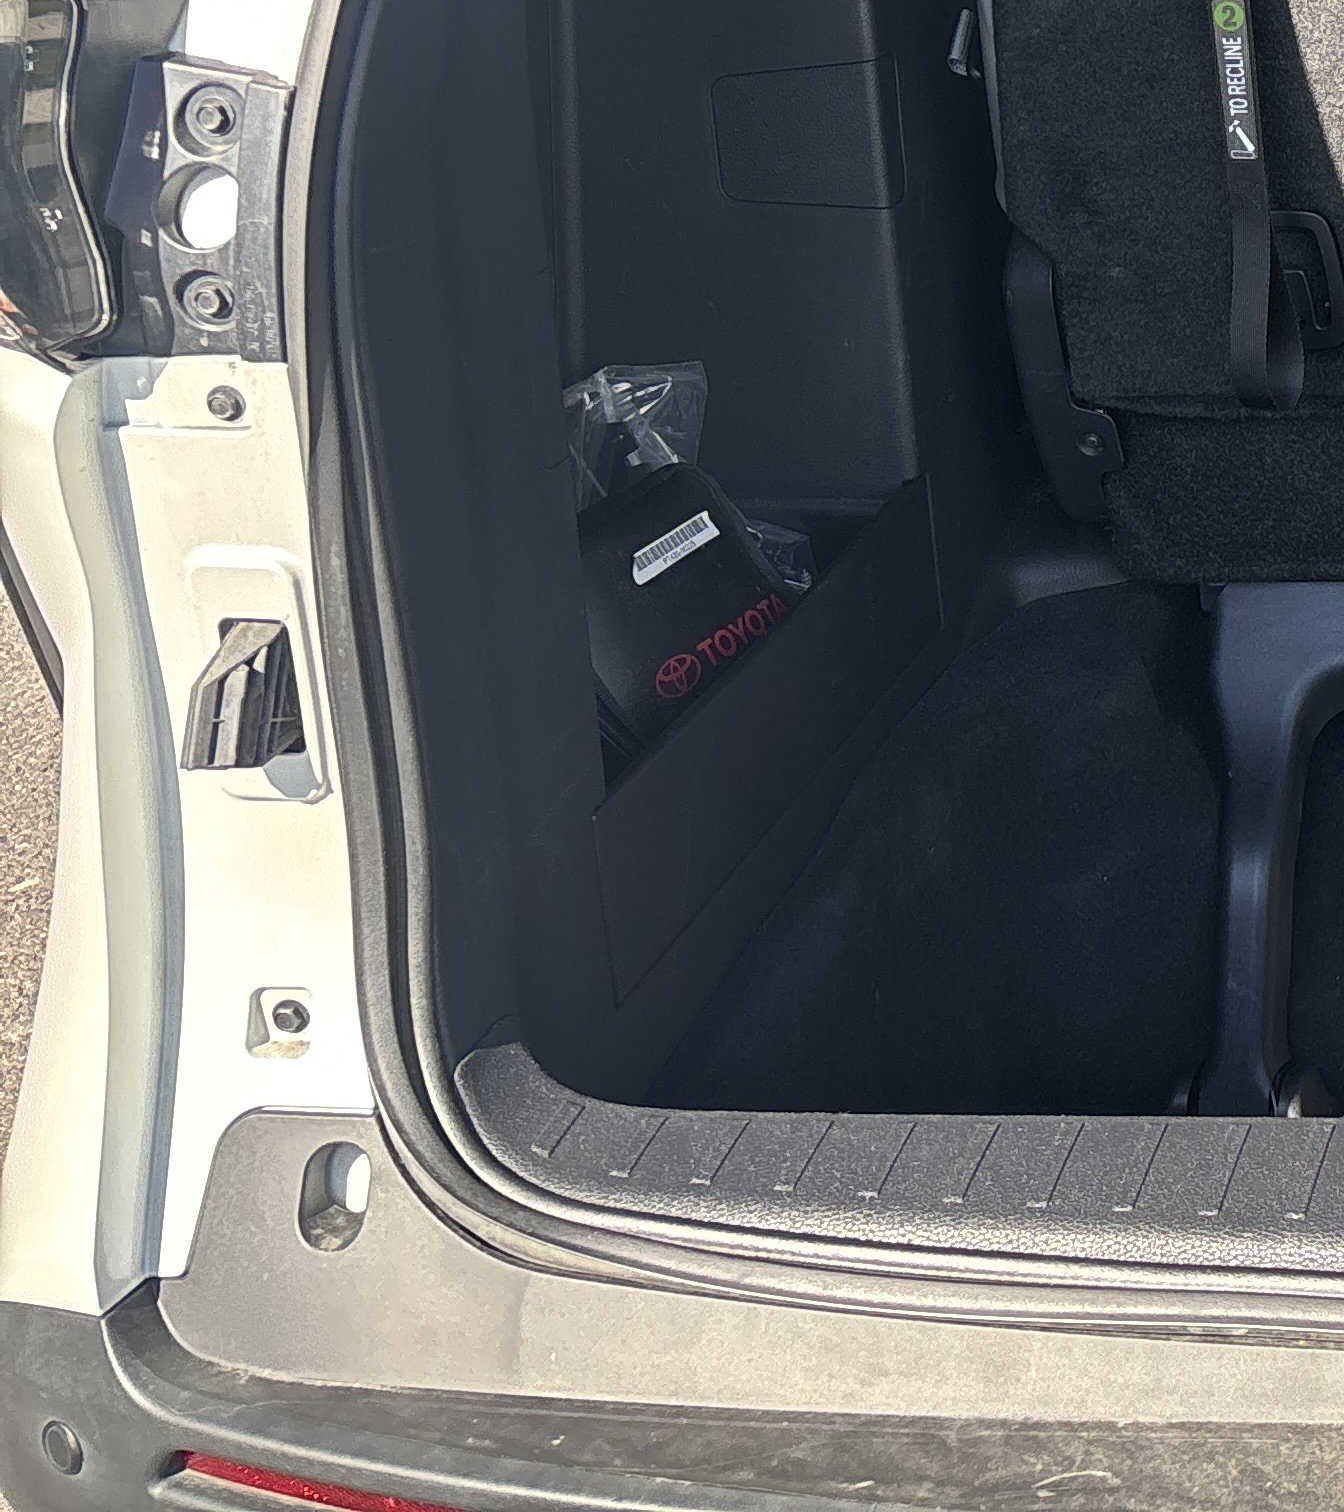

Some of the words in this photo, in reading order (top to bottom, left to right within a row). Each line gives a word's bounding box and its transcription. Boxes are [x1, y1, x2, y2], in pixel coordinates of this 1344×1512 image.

[1221, 36, 1247, 95] RECLINE
[1229, 98, 1249, 117] TO
[696, 593, 785, 666] TOYOTA
